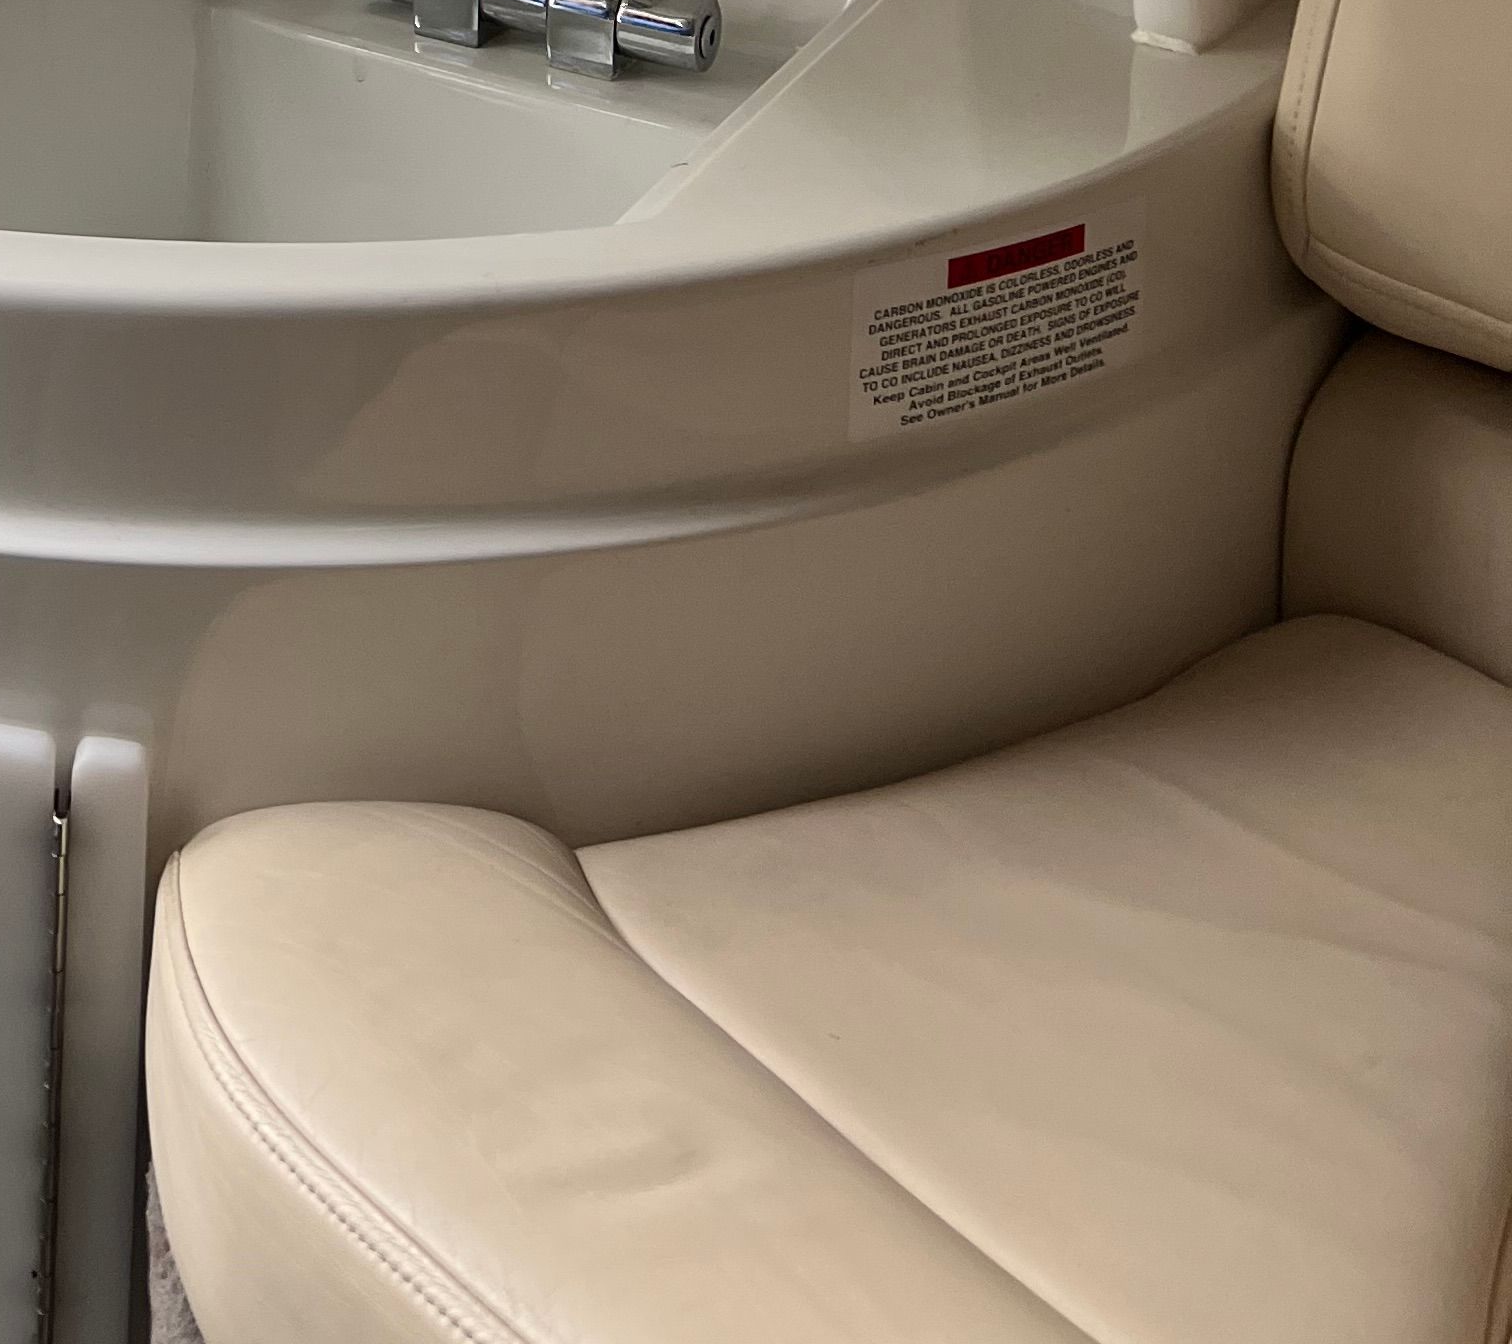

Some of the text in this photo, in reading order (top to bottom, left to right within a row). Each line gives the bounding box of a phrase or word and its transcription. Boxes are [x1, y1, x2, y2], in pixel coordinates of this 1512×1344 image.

[874, 302, 923, 321] CARBON
[926, 286, 983, 309] MONOXIDE
[1116, 240, 1134, 253] AND
[879, 320, 957, 347] GENERATORS
[959, 306, 1008, 329] EXHAUST
[1011, 294, 1053, 314] CARBON
[1055, 276, 1104, 300] MONOXIDE
[950, 304, 968, 316] ALL
[973, 288, 1025, 311] GASOLINE
[1028, 272, 1076, 295] POWERED
[1078, 258, 1117, 280] ENGINES
[1120, 251, 1138, 264] AND
[859, 362, 898, 379] CAUSE
[902, 353, 937, 370] BRAIN
[939, 341, 985, 361] DAMAGE
[1048, 313, 1076, 330] SIGNS
[1093, 290, 1140, 315] EXPOSURE
[881, 343, 922, 361] DIRECT
[925, 336, 949, 350] AND
[951, 318, 1017, 344] PROLONGED
[1020, 301, 1072, 326] EXPOSURE
[1105, 283, 1126, 297] WILL
[901, 364, 949, 384] INCLUDE
[1001, 335, 1051, 358] DIZZINESS
[1054, 328, 1074, 342] AND
[1076, 306, 1135, 335] DROWSINESS
[873, 392, 905, 405] Keep
[908, 382, 944, 397] Cabin
[948, 374, 970, 388] and
[973, 361, 1017, 382] Cockpit
[1020, 352, 1051, 368] Areas
[1054, 342, 1076, 356] Well
[900, 414, 923, 426] See
[926, 401, 975, 419] Owner's
[978, 386, 1019, 405] Manual
[1023, 381, 1037, 392] for
[1041, 372, 1067, 387] More
[909, 393, 944, 410] Avoid
[948, 380, 1001, 402] Blockage
[1019, 359, 1063, 381] Exhaust
